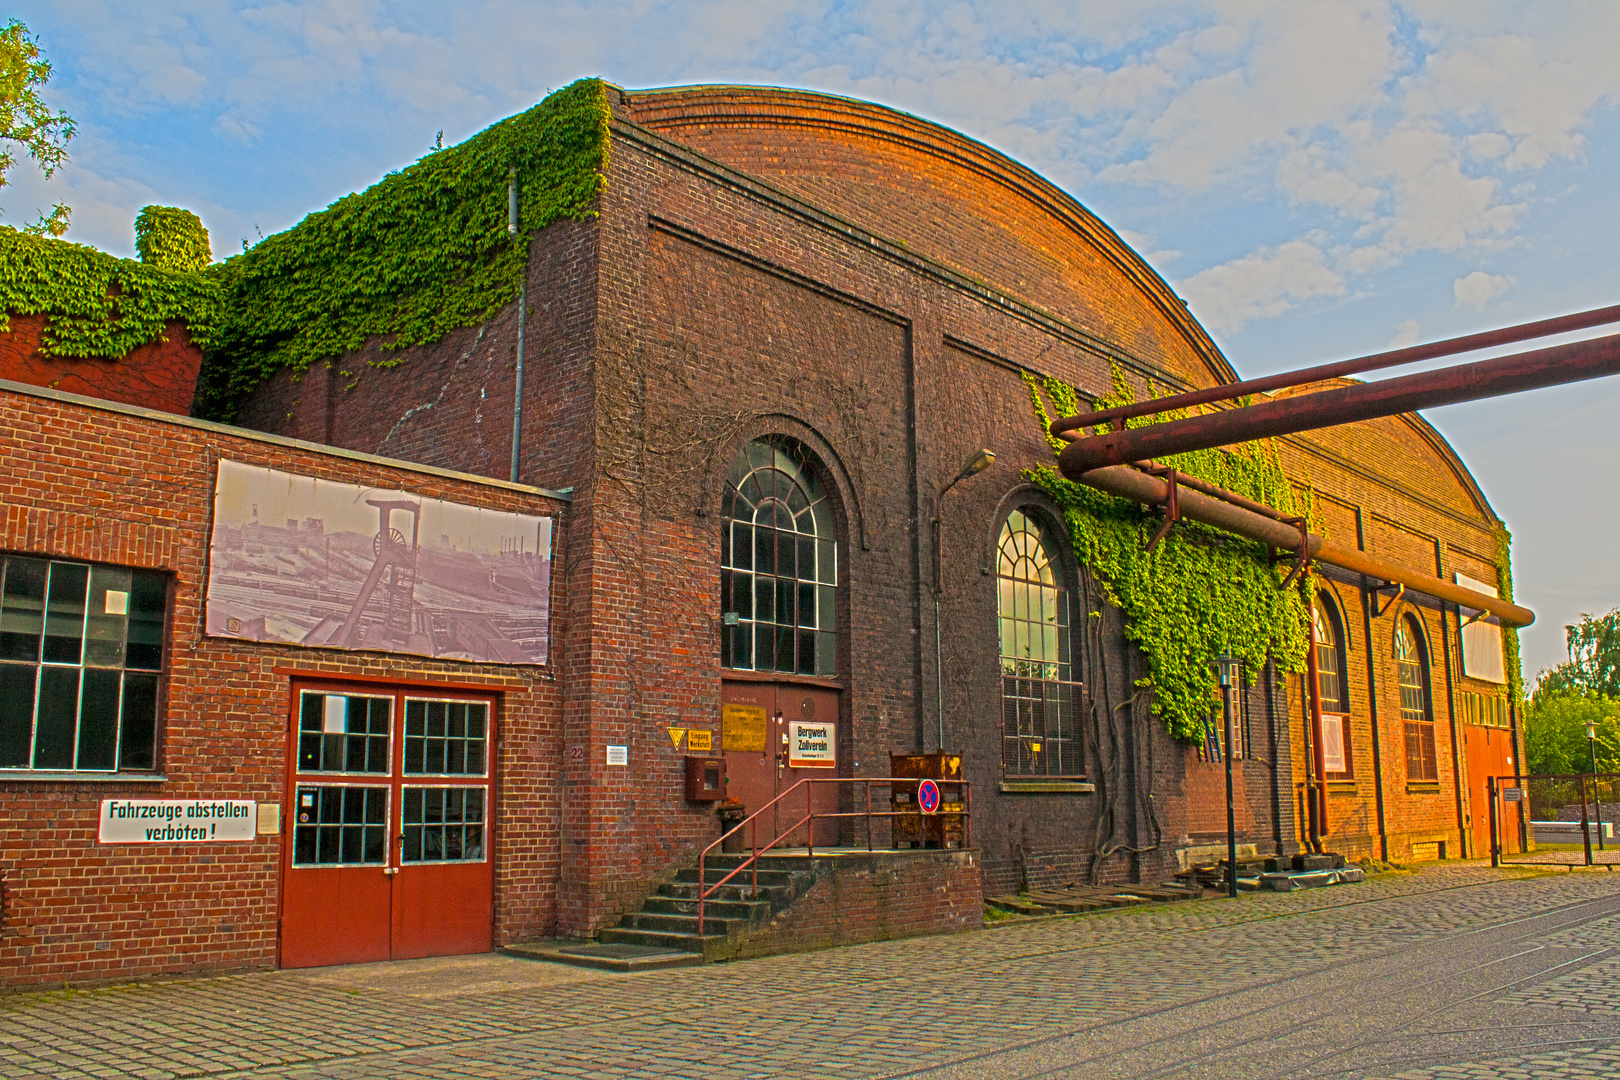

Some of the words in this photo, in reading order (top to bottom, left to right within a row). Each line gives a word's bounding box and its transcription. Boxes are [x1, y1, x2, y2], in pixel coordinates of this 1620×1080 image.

[691, 732, 709, 741] Eingang
[798, 725, 827, 739] Bergwerk
[798, 739, 828, 751] Zollverein
[572, 748, 583, 758] 22
[110, 801, 183, 821] Fahrzeuge
[187, 801, 249, 818] abstellen
[145, 824, 207, 840] verboten
[210, 823, 216, 840] !
